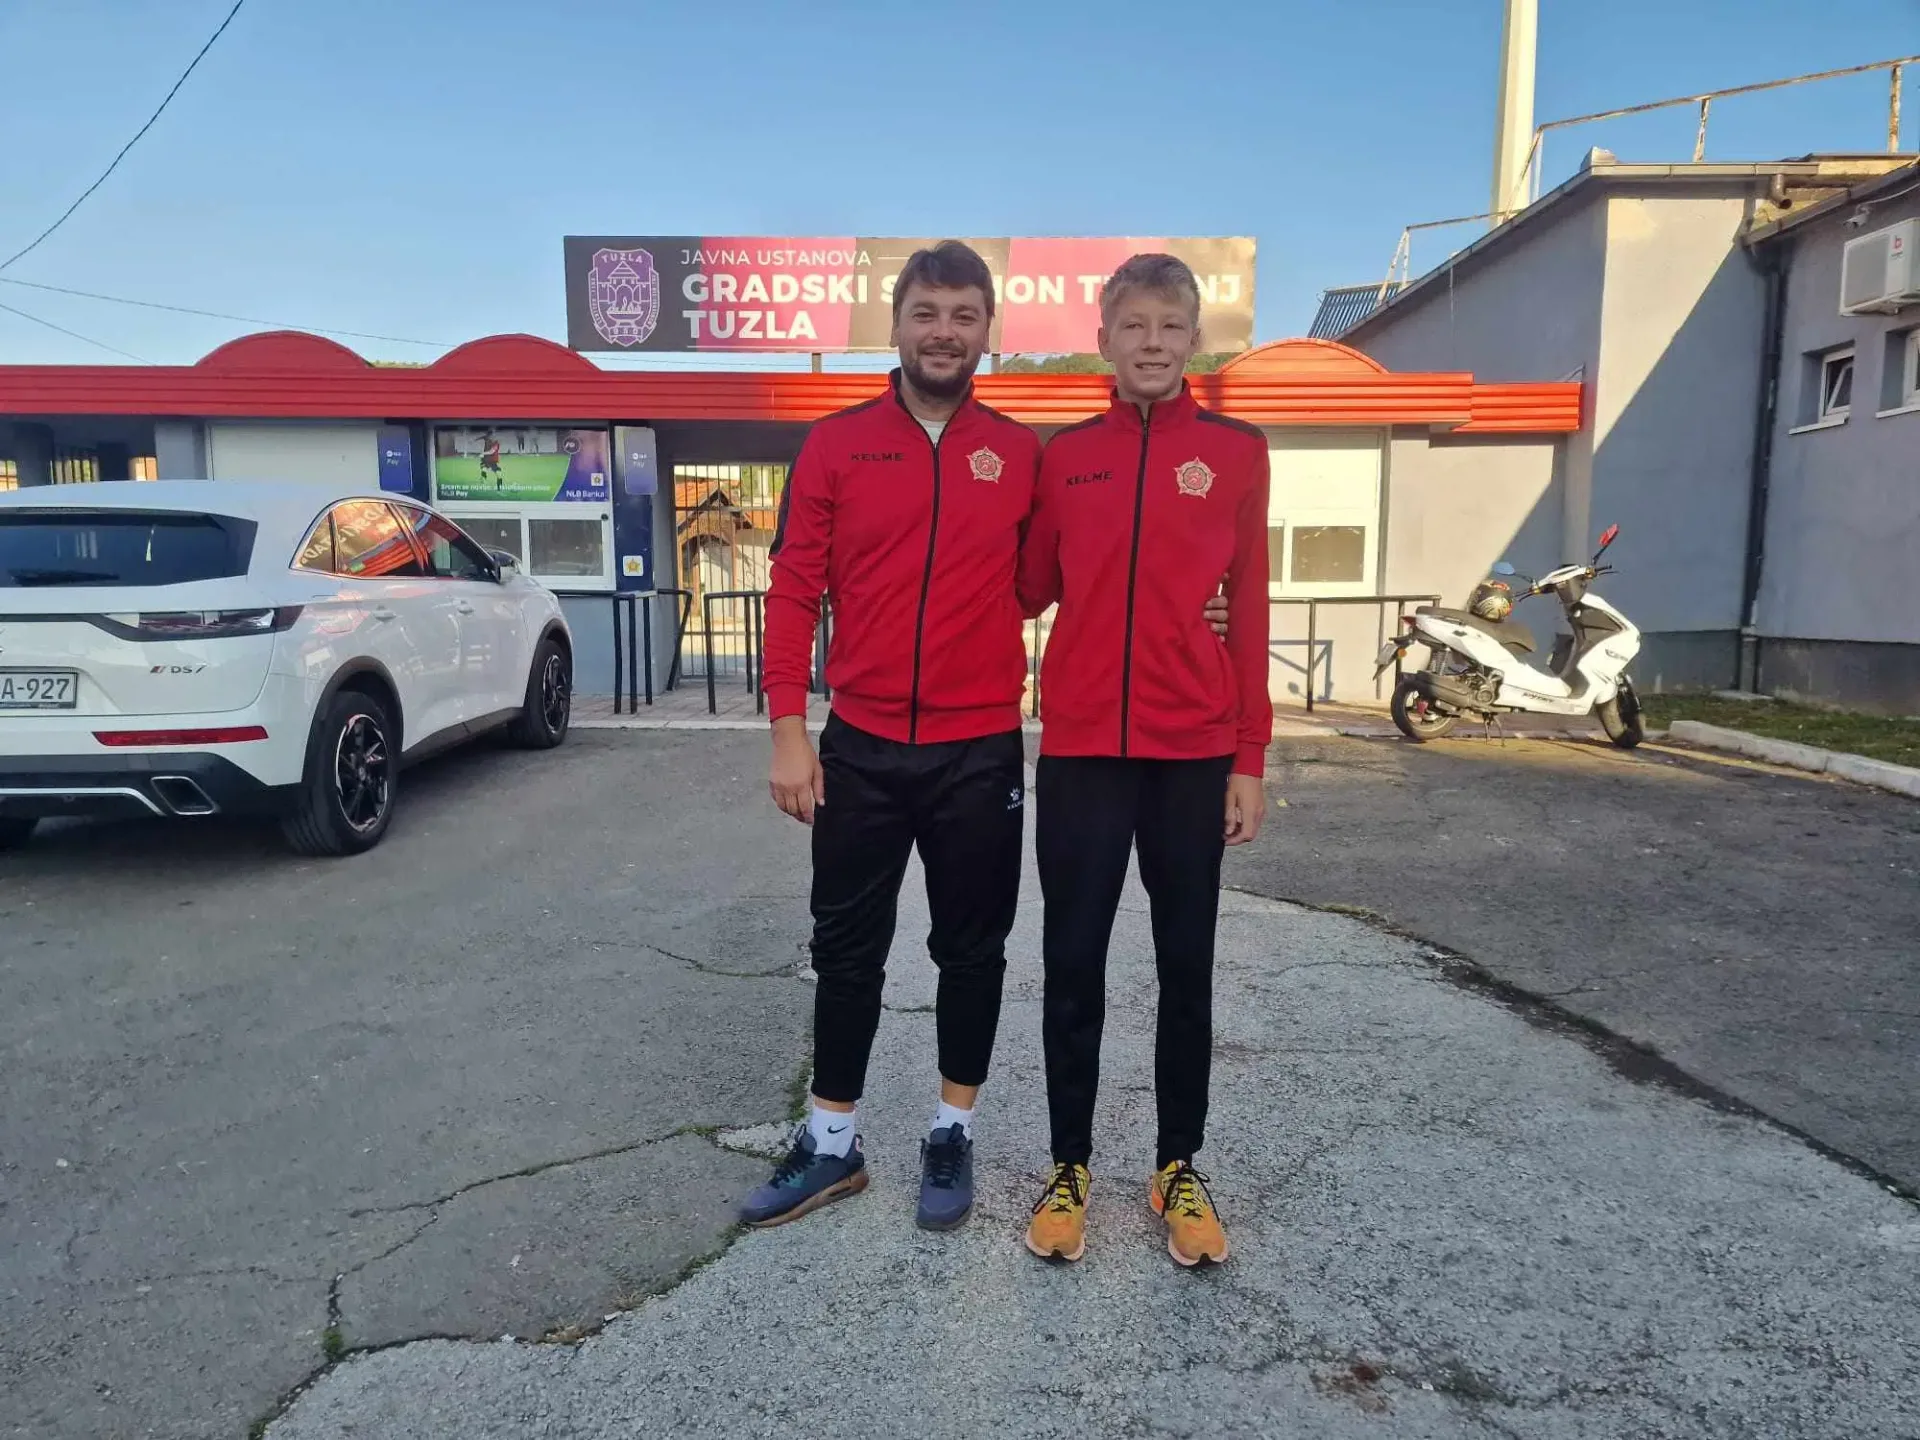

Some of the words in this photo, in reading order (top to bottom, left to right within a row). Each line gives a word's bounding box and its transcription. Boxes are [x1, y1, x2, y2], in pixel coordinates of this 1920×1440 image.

[601, 253, 643, 263] TUZLA
[680, 250, 751, 265] JAVNA
[757, 250, 872, 266] USTANOVA
[682, 273, 868, 304] GRADSKI
[880, 273, 1065, 304] SION
[682, 310, 818, 339] TUZLA
[851, 452, 904, 462] KELME
[1066, 470, 1114, 488] KELME
[455, 490, 469, 498] Pay
[566, 490, 582, 498] NLB
[582, 490, 605, 498] Banka
